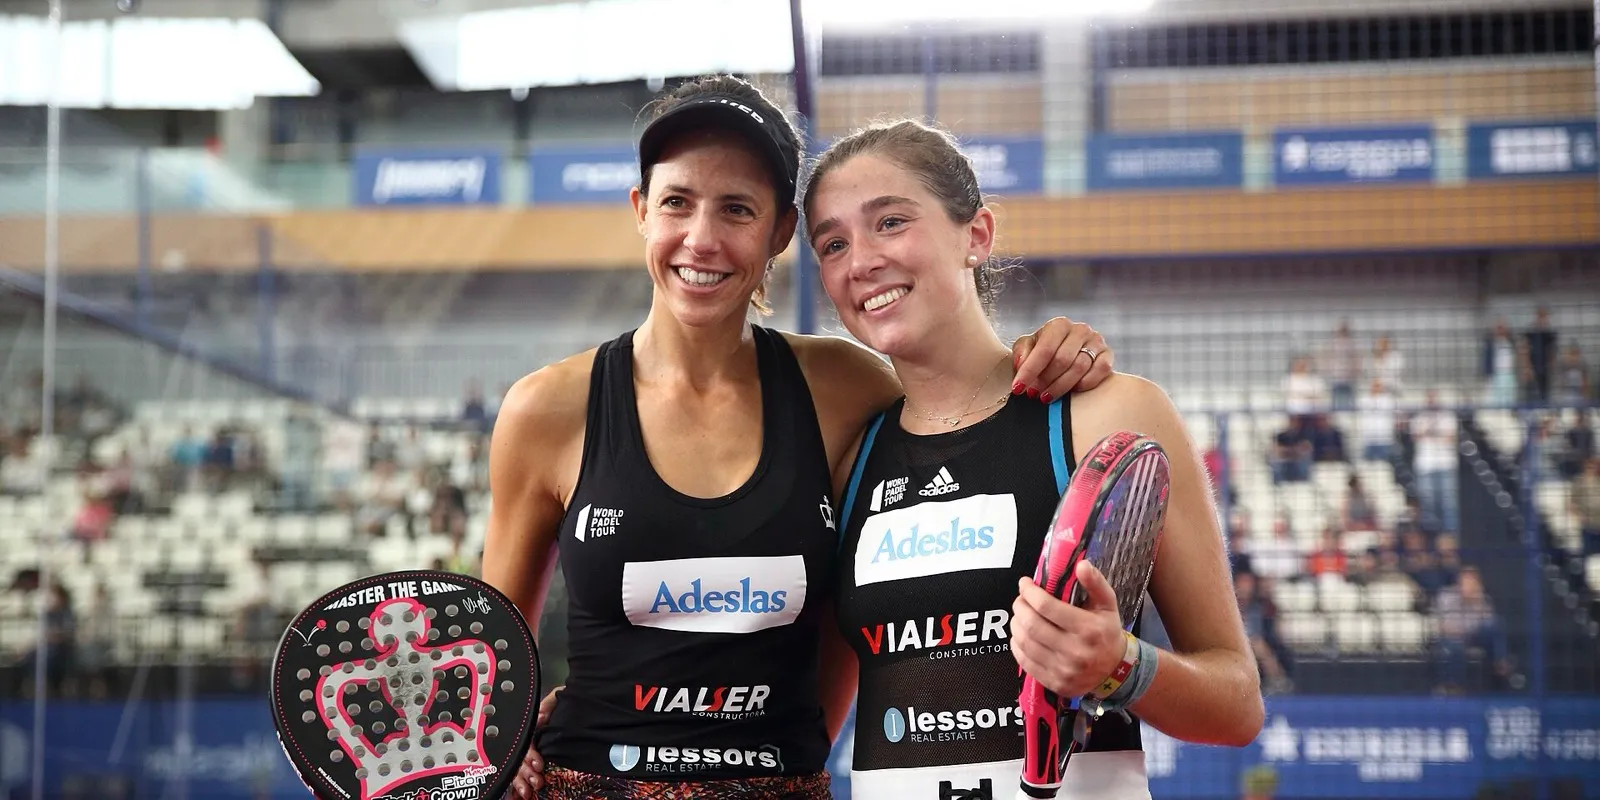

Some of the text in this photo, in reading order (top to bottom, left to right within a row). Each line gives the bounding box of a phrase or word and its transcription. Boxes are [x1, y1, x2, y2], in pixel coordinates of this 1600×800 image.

[886, 476, 909, 490] WORLD
[918, 482, 960, 497] adidas
[885, 486, 907, 498] PADEL
[884, 493, 904, 507] TOUR
[593, 508, 624, 518] WORLD
[591, 517, 620, 527] PADEL
[590, 526, 616, 538] TOUR
[871, 517, 994, 564] Adeslas
[388, 581, 418, 600] THE
[421, 580, 467, 596] GAM
[649, 577, 787, 613] Adeslas
[862, 609, 1009, 655] VIALSER
[929, 643, 1011, 660] CONSTRUCTOR
[634, 685, 770, 712] VIALSER
[692, 711, 766, 720] CONSTRUCTORA
[907, 706, 1024, 733] lessors
[911, 731, 976, 742] REAL ESTATE
[646, 746, 777, 768] lessors
[645, 763, 676, 772] REAL
[442, 775, 486, 790] Piton
[431, 787, 476, 800] Crown
